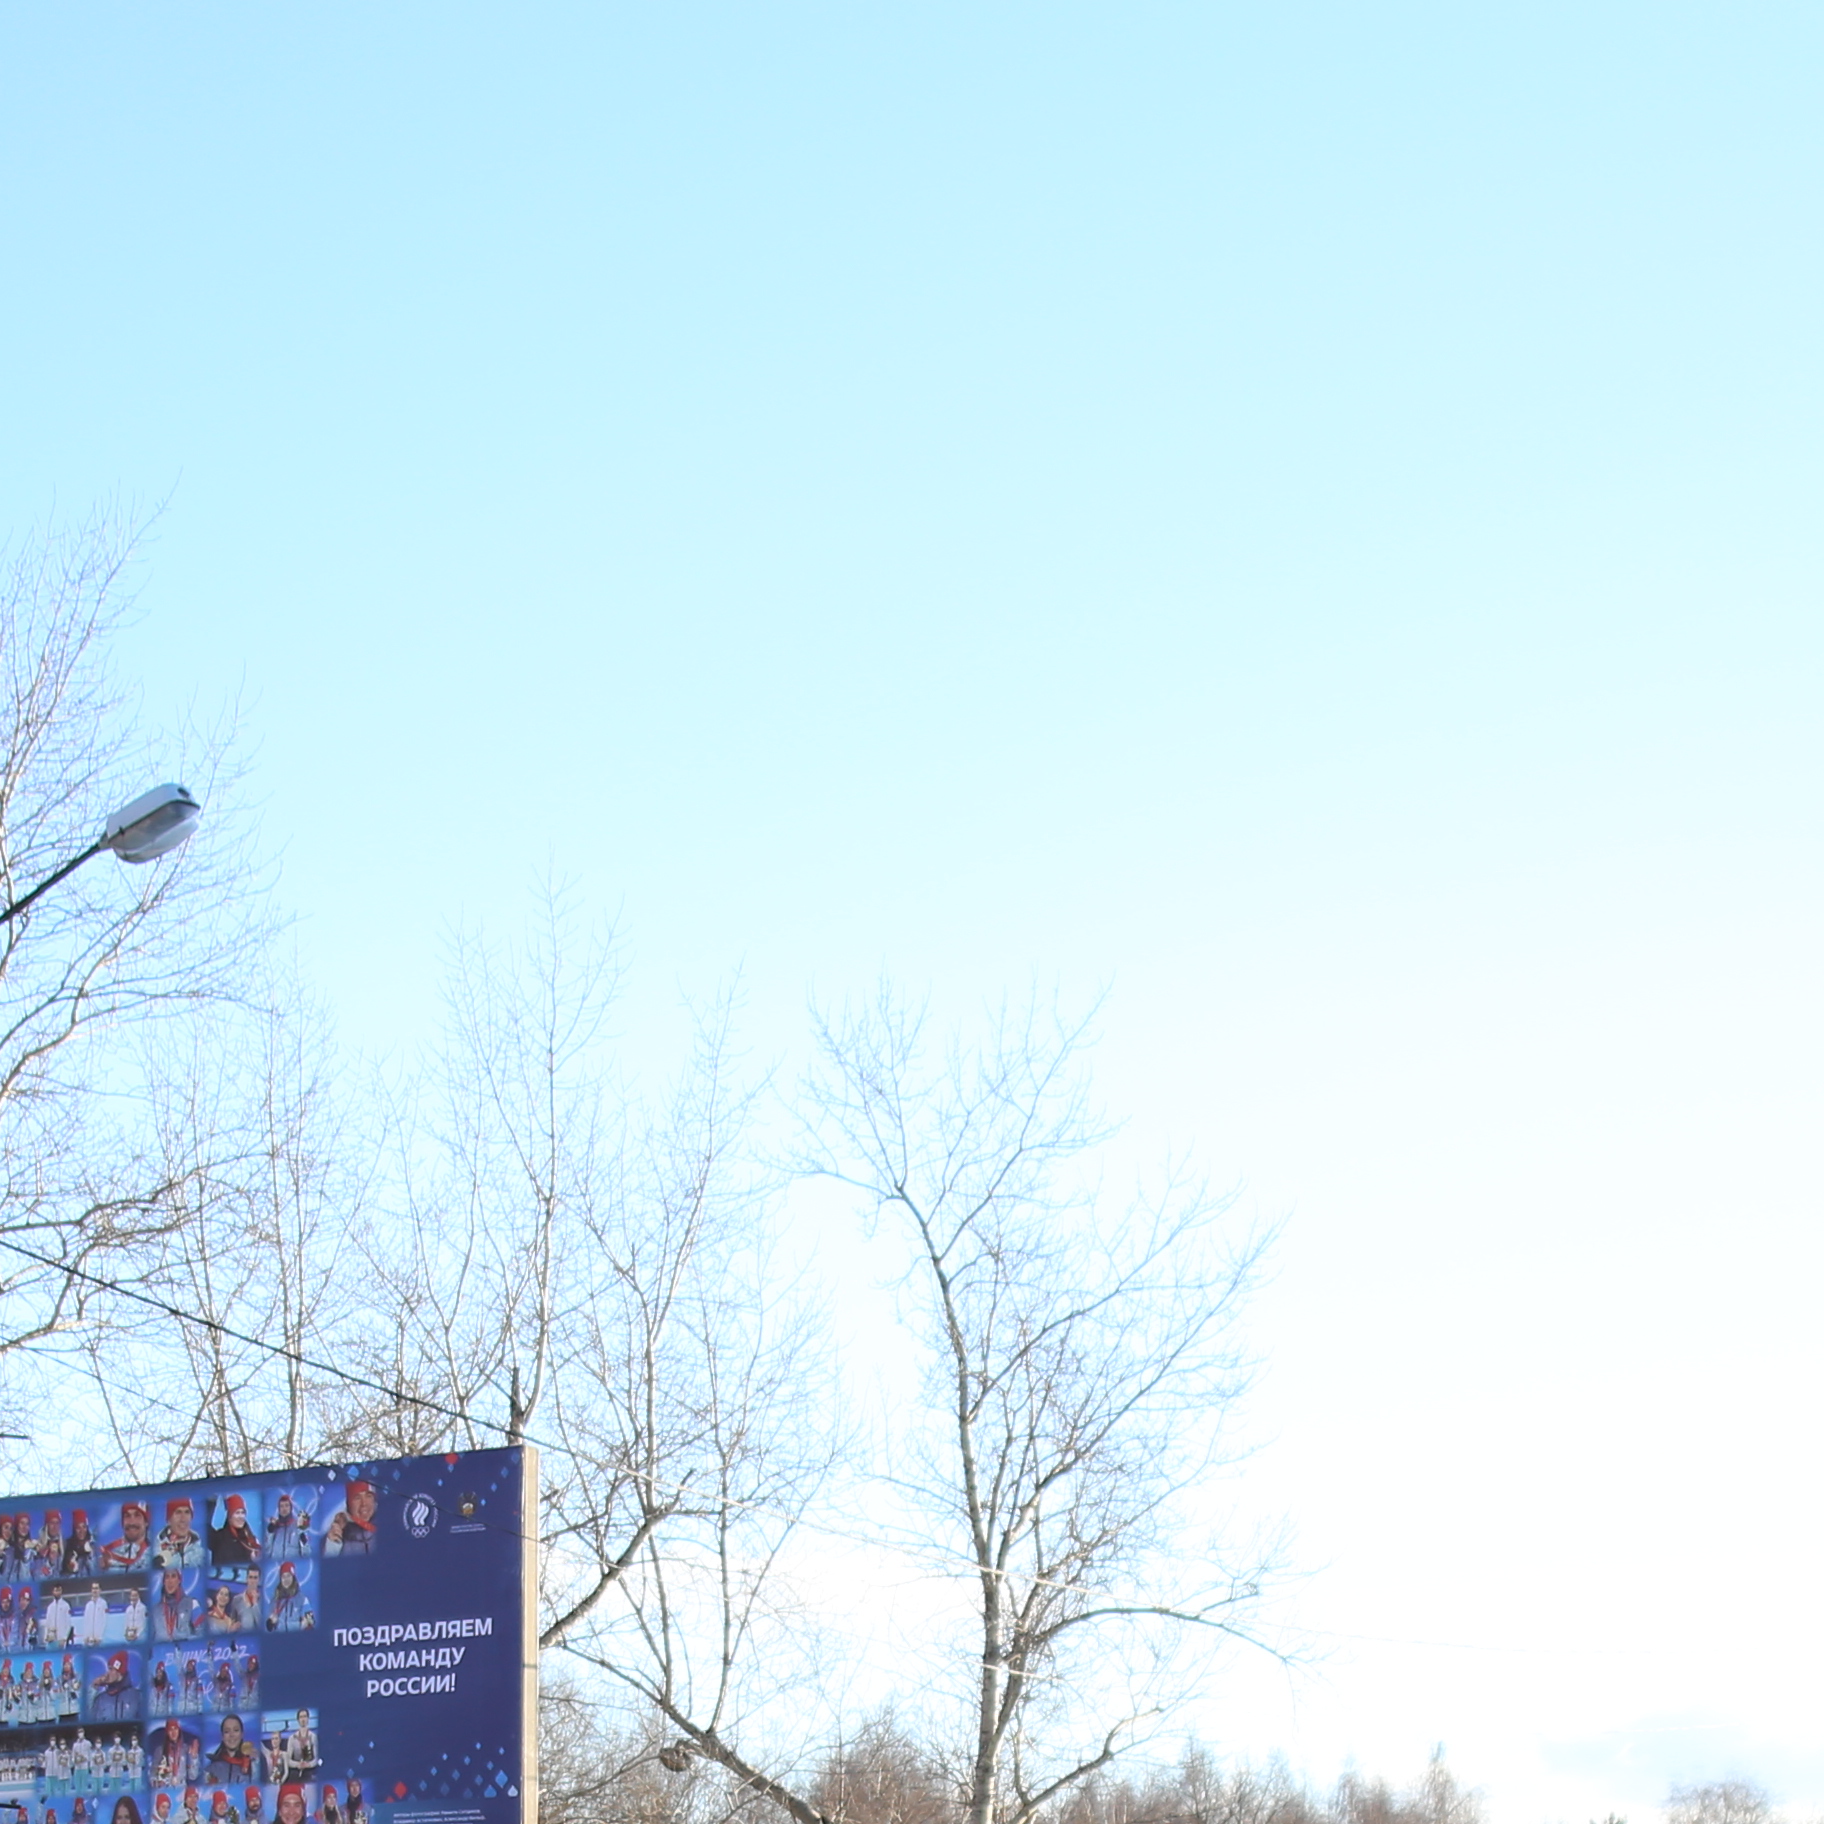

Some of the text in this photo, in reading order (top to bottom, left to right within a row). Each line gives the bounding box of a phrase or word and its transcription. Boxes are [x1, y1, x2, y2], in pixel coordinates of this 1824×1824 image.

[333, 1617, 493, 1647] ПОЗДРАВЛЯЕМ
[213, 1645, 250, 1661] 202
[359, 1646, 466, 1671] КОМАНДУ
[366, 1673, 456, 1698] РОССИИ!
